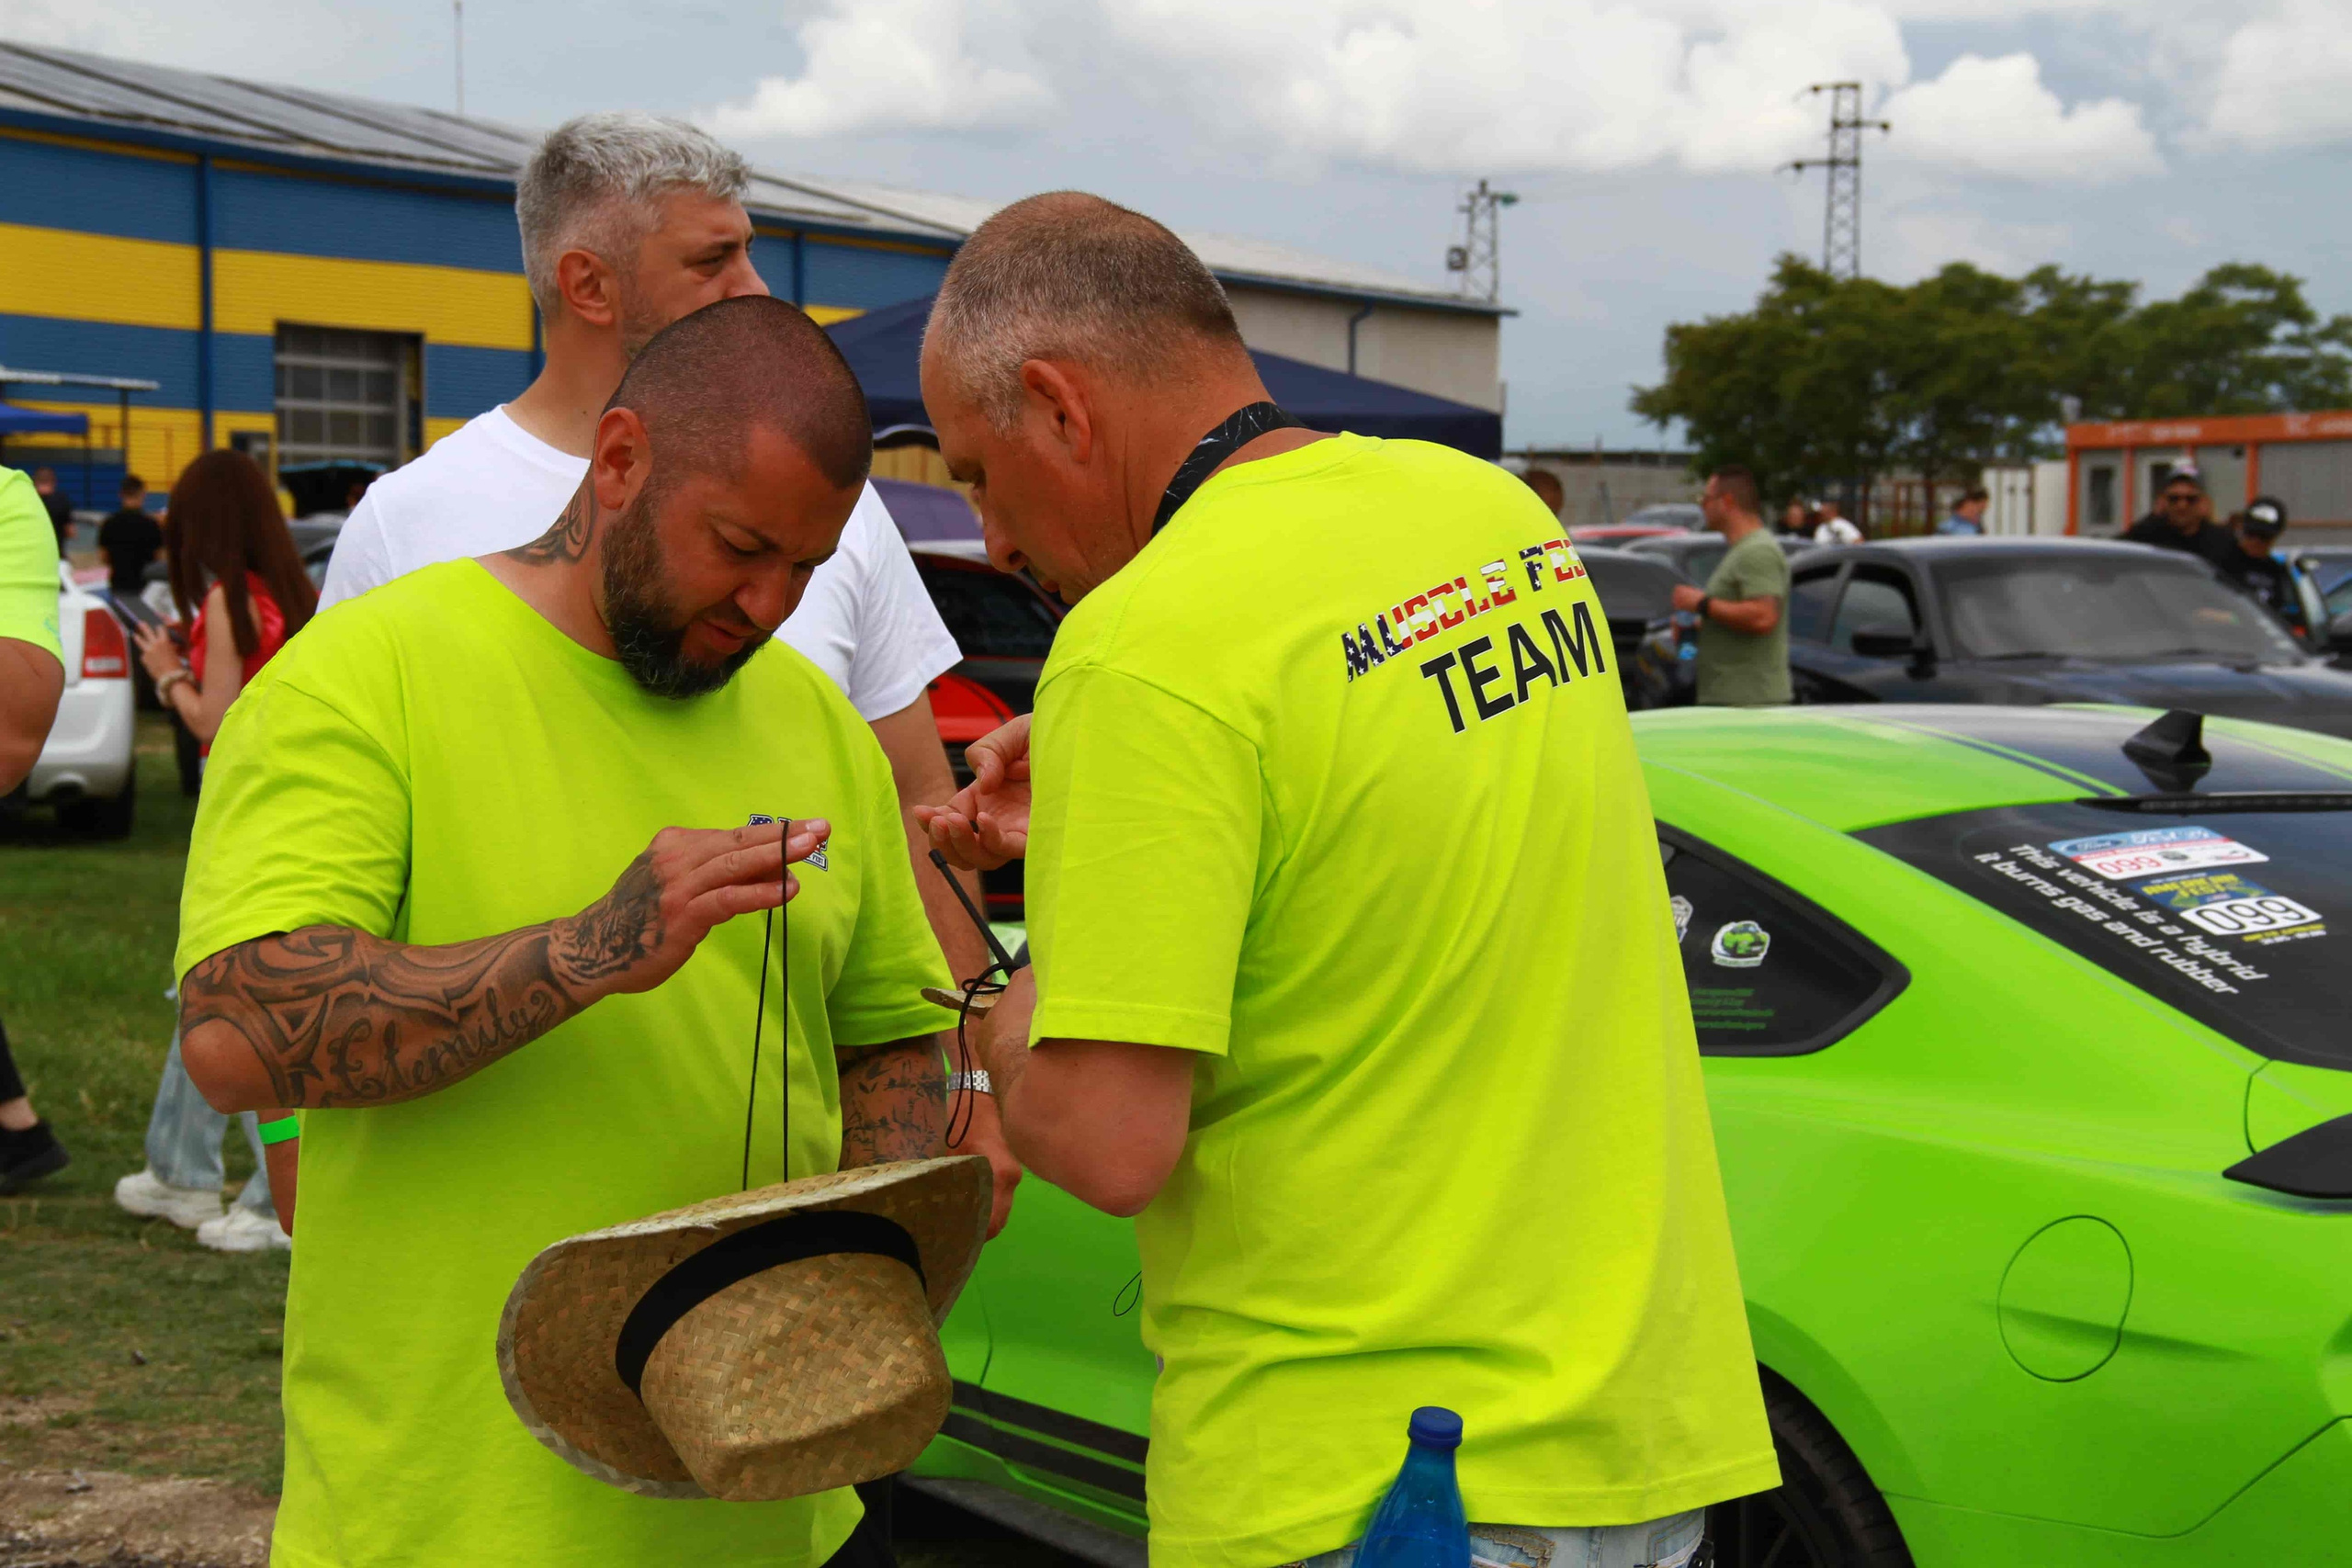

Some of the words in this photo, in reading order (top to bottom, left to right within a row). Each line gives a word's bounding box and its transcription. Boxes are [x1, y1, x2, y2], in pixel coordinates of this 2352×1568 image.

[1340, 558, 1517, 682] MUSCLE
[1419, 601, 1606, 734] TEAM
[1973, 852, 2002, 863] it
[1991, 861, 2065, 897] burns
[2052, 897, 2111, 921] gas
[2102, 921, 2165, 947] and
[2149, 947, 2239, 994] rubber
[2008, 843, 2061, 869] This
[2056, 868, 2141, 910] vehicle
[2133, 910, 2165, 924] is
[2158, 924, 2184, 935] a
[2177, 935, 2269, 981] hybrid
[2097, 855, 2162, 874] 099
[2195, 898, 2309, 931] 099
[327, 987, 557, 1100] Eternity
